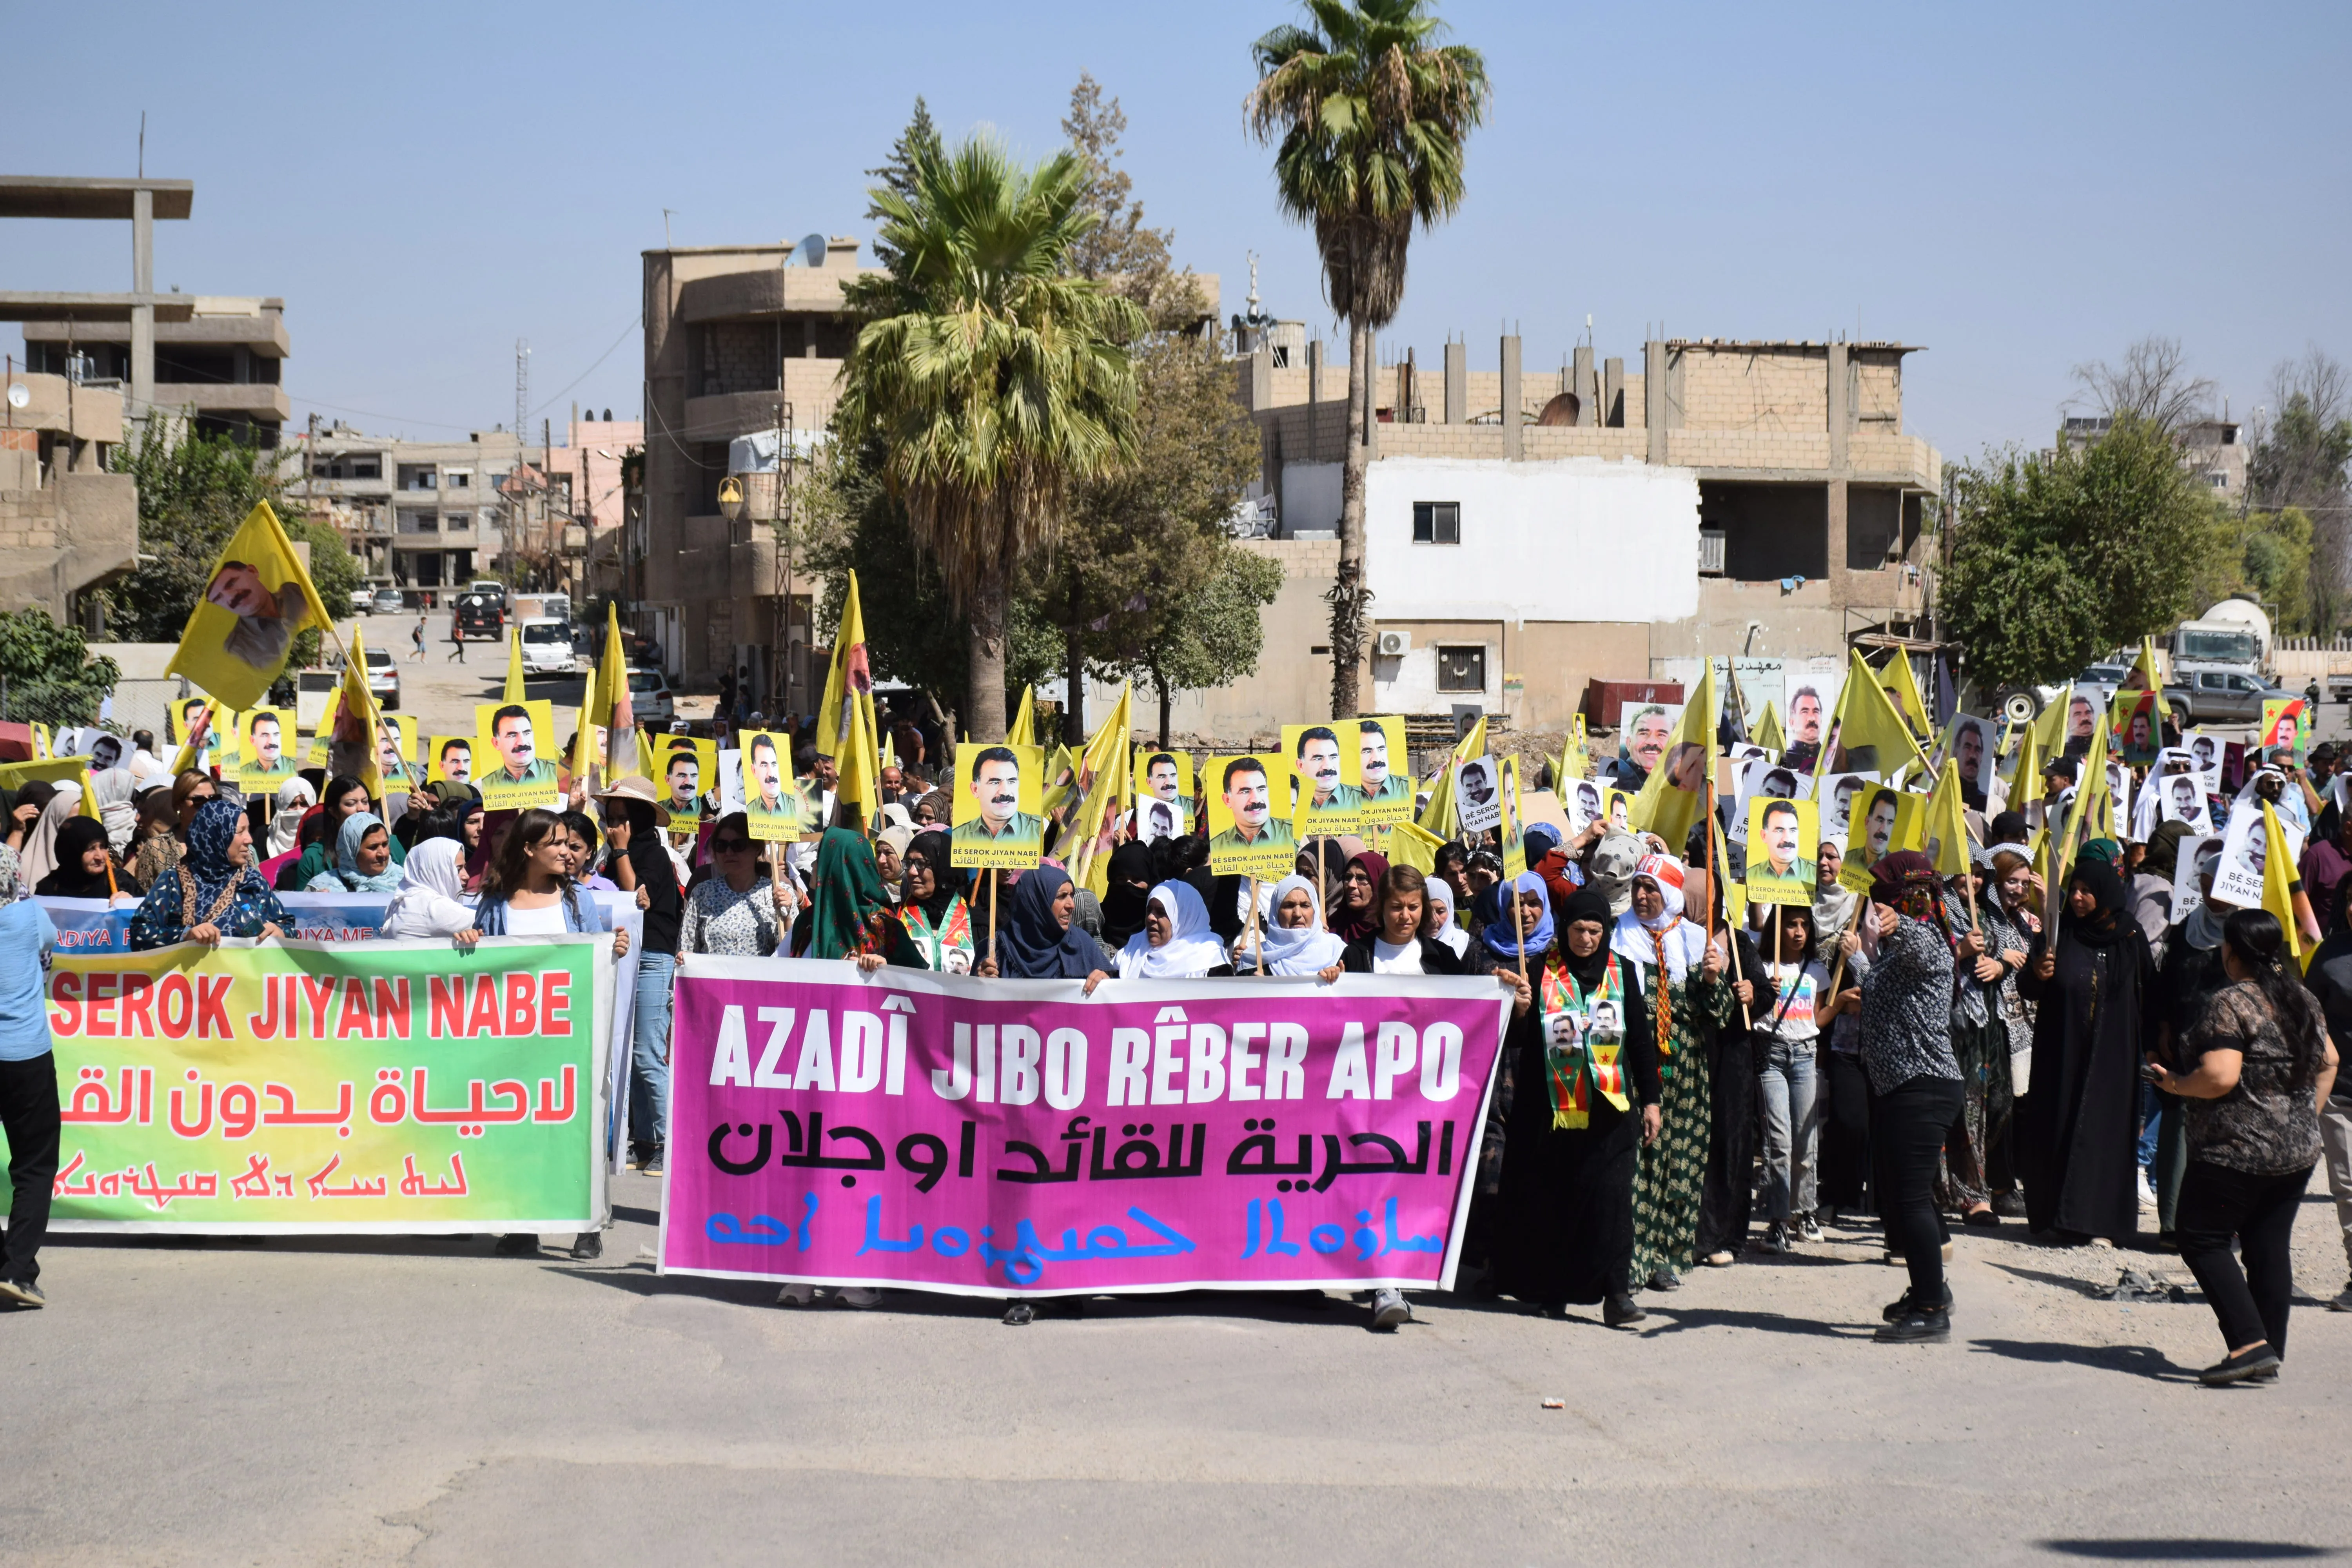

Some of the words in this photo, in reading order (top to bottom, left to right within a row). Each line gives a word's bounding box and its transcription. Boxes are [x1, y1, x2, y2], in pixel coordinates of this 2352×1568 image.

[486, 800, 507, 808] القائد
[533, 797, 550, 806] حياة
[1465, 811, 1475, 820] BÊ
[1476, 802, 1500, 816] SEROK
[1464, 817, 1484, 829] JIYAN
[1485, 810, 1501, 821] NAB
[1334, 825, 1352, 833] حياة
[1735, 825, 1748, 835] JIY
[781, 832, 793, 840] حياة
[953, 856, 978, 864] القائد
[982, 858, 1005, 867] بدون
[1009, 858, 1027, 867] حياة
[1214, 864, 1238, 873] القائد
[1241, 864, 1263, 872] بدون
[1267, 862, 1285, 871] حياة
[1638, 855, 1663, 876] APO
[1847, 871, 1862, 881] SEROK
[2229, 872, 2243, 883] BÊ
[2245, 877, 2263, 888] SER
[2220, 881, 2250, 897] JIYAN
[1791, 896, 1806, 904] حياة
[2183, 896, 2196, 905] BÊ
[48, 970, 236, 1040] SEROK
[249, 972, 412, 1041] JIYAN
[426, 969, 574, 1040] NABE
[709, 994, 917, 1096] AZADÎ
[931, 1021, 1088, 1111] JIBO
[1107, 1005, 1310, 1107] RÊBER
[1326, 1021, 1464, 1102] APO
[169, 1067, 356, 1140] بدون
[707, 1109, 976, 1194] اوجلان
[996, 1116, 1207, 1184] للقائد
[1226, 1118, 1455, 1194] الحرية
